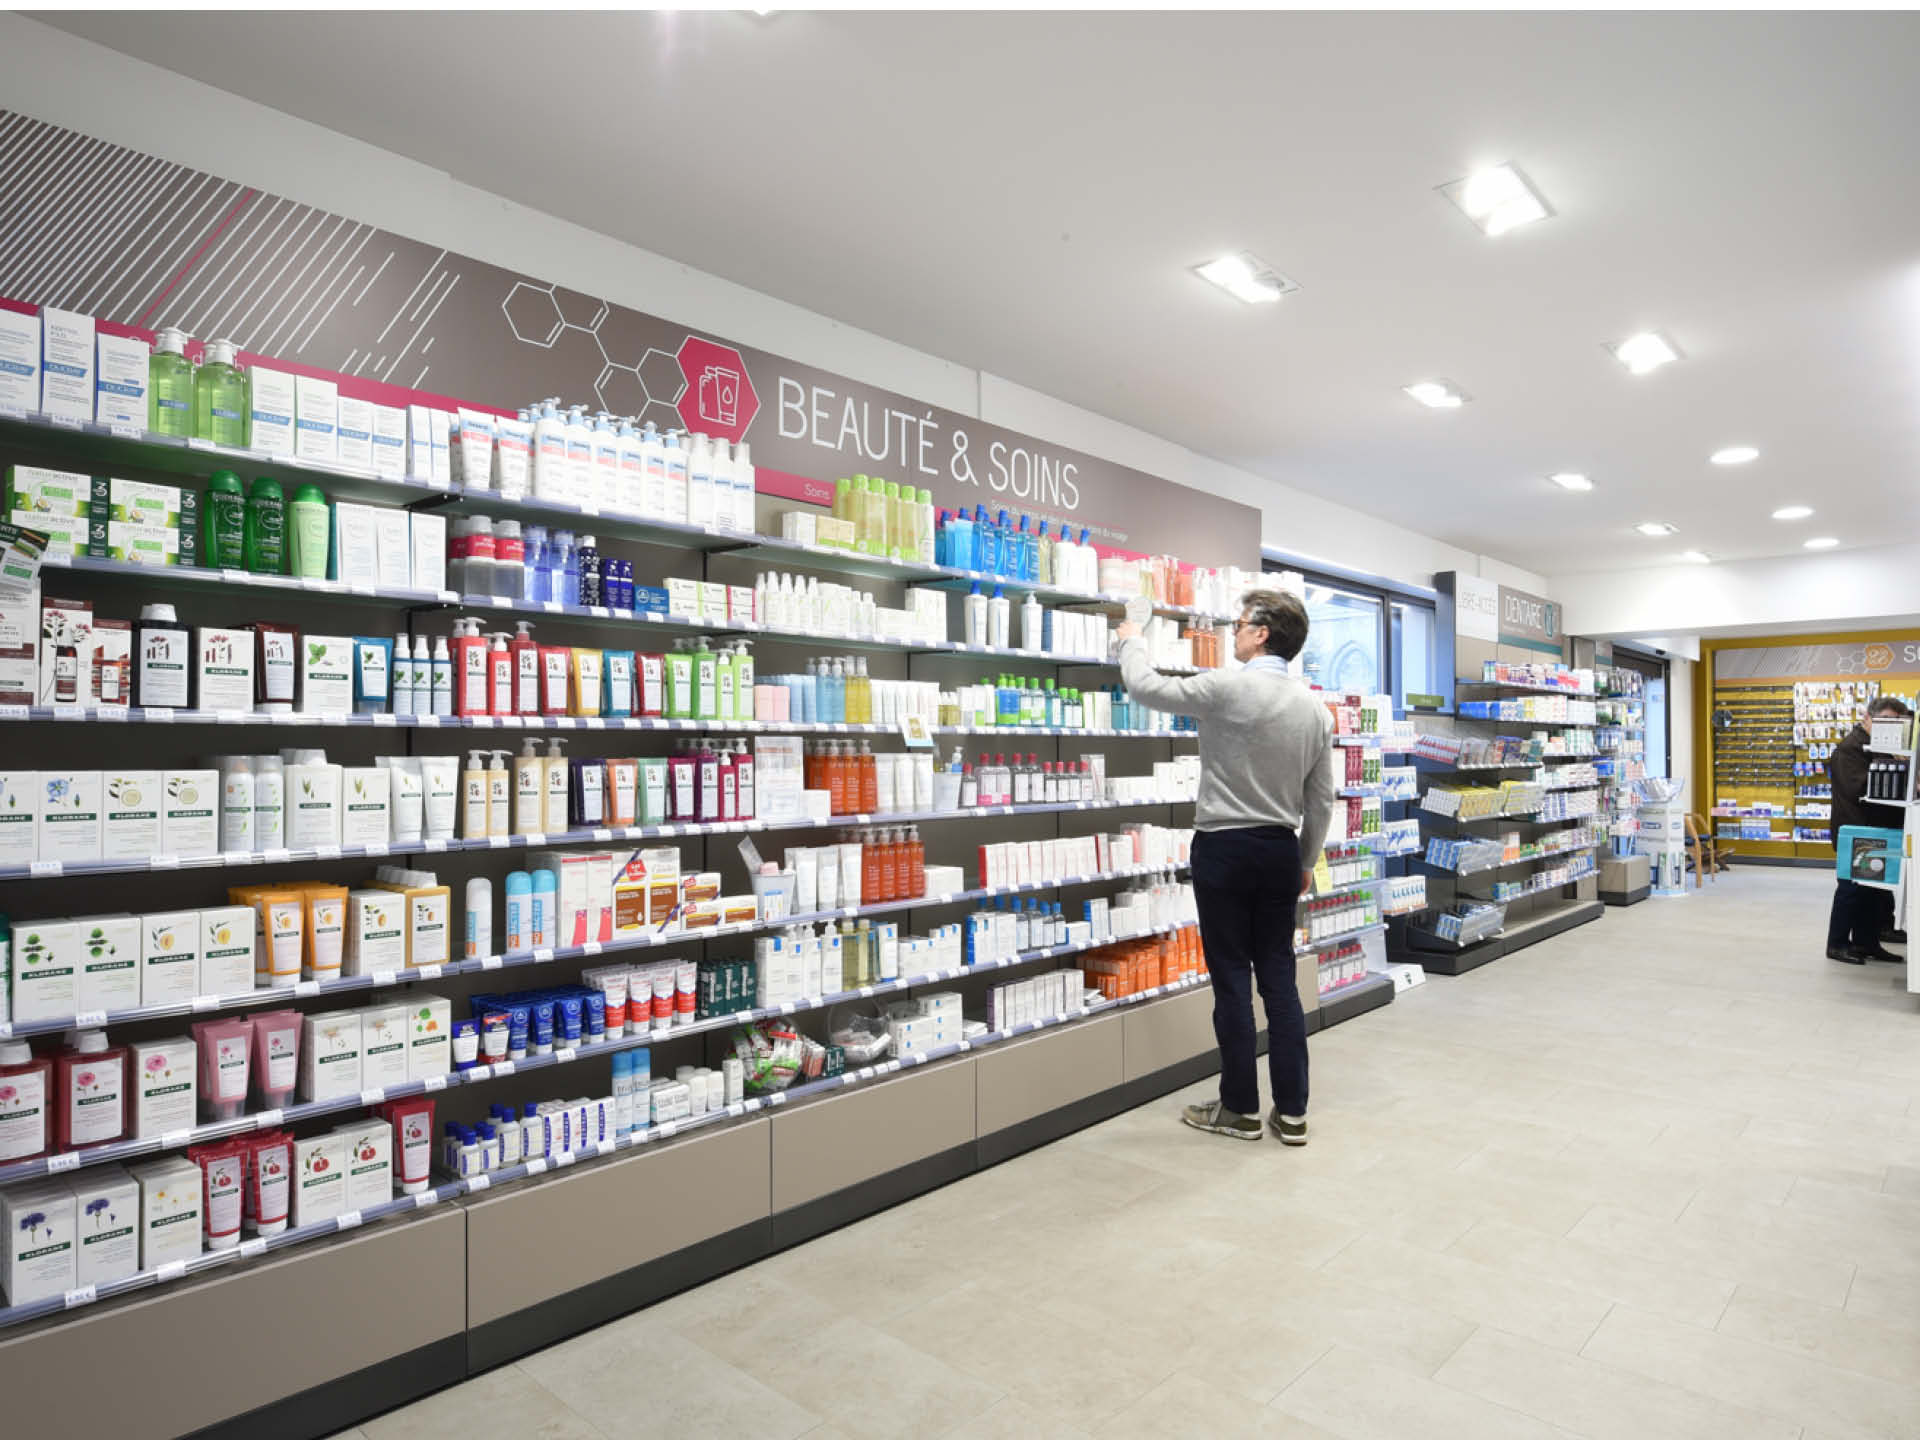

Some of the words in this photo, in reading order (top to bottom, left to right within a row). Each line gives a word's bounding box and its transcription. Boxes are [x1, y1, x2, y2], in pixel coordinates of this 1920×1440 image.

[778, 375, 939, 476] BEAUTÉ
[950, 430, 979, 487] &
[988, 441, 1080, 510] SOINS
[1903, 644, 1920, 663] S
